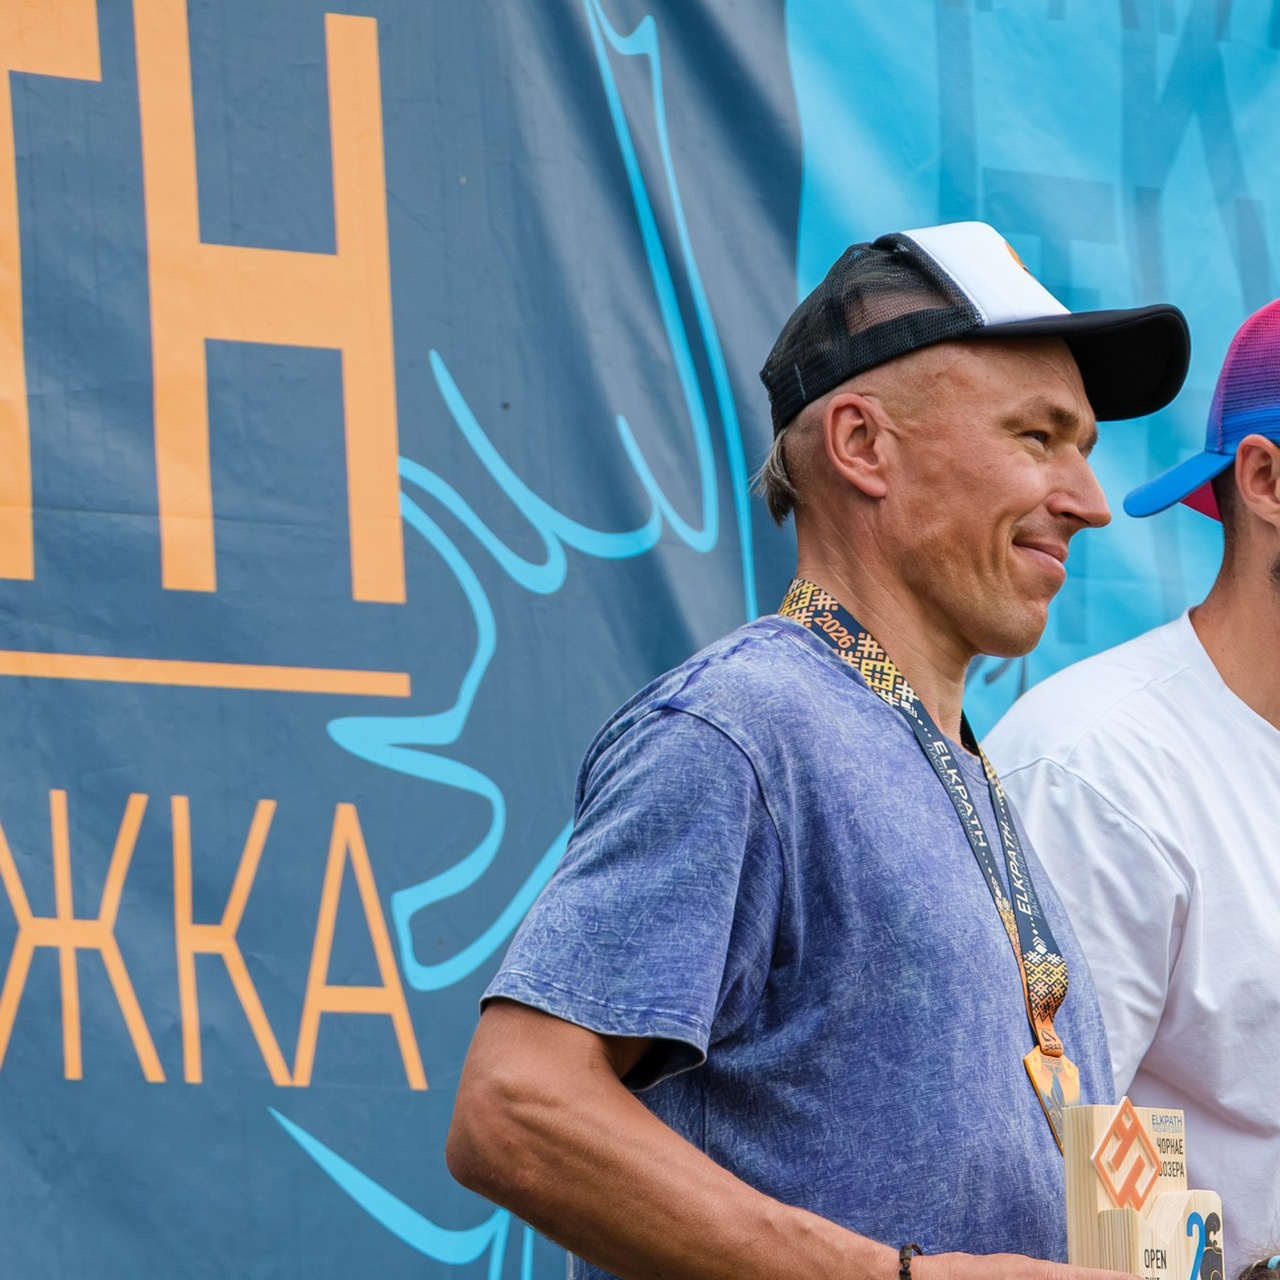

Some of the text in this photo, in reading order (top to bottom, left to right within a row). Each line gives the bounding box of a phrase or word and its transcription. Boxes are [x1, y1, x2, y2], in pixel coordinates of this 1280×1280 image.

[814, 612, 856, 648] 2026
[933, 741, 988, 847] ELKPATH
[1000, 820, 1033, 916] ELKPATH
[1151, 1114, 1183, 1126] ELKPATH
[1156, 1137, 1184, 1155] ЧОРНАЕ
[1144, 1248, 1167, 1270] OPEN
